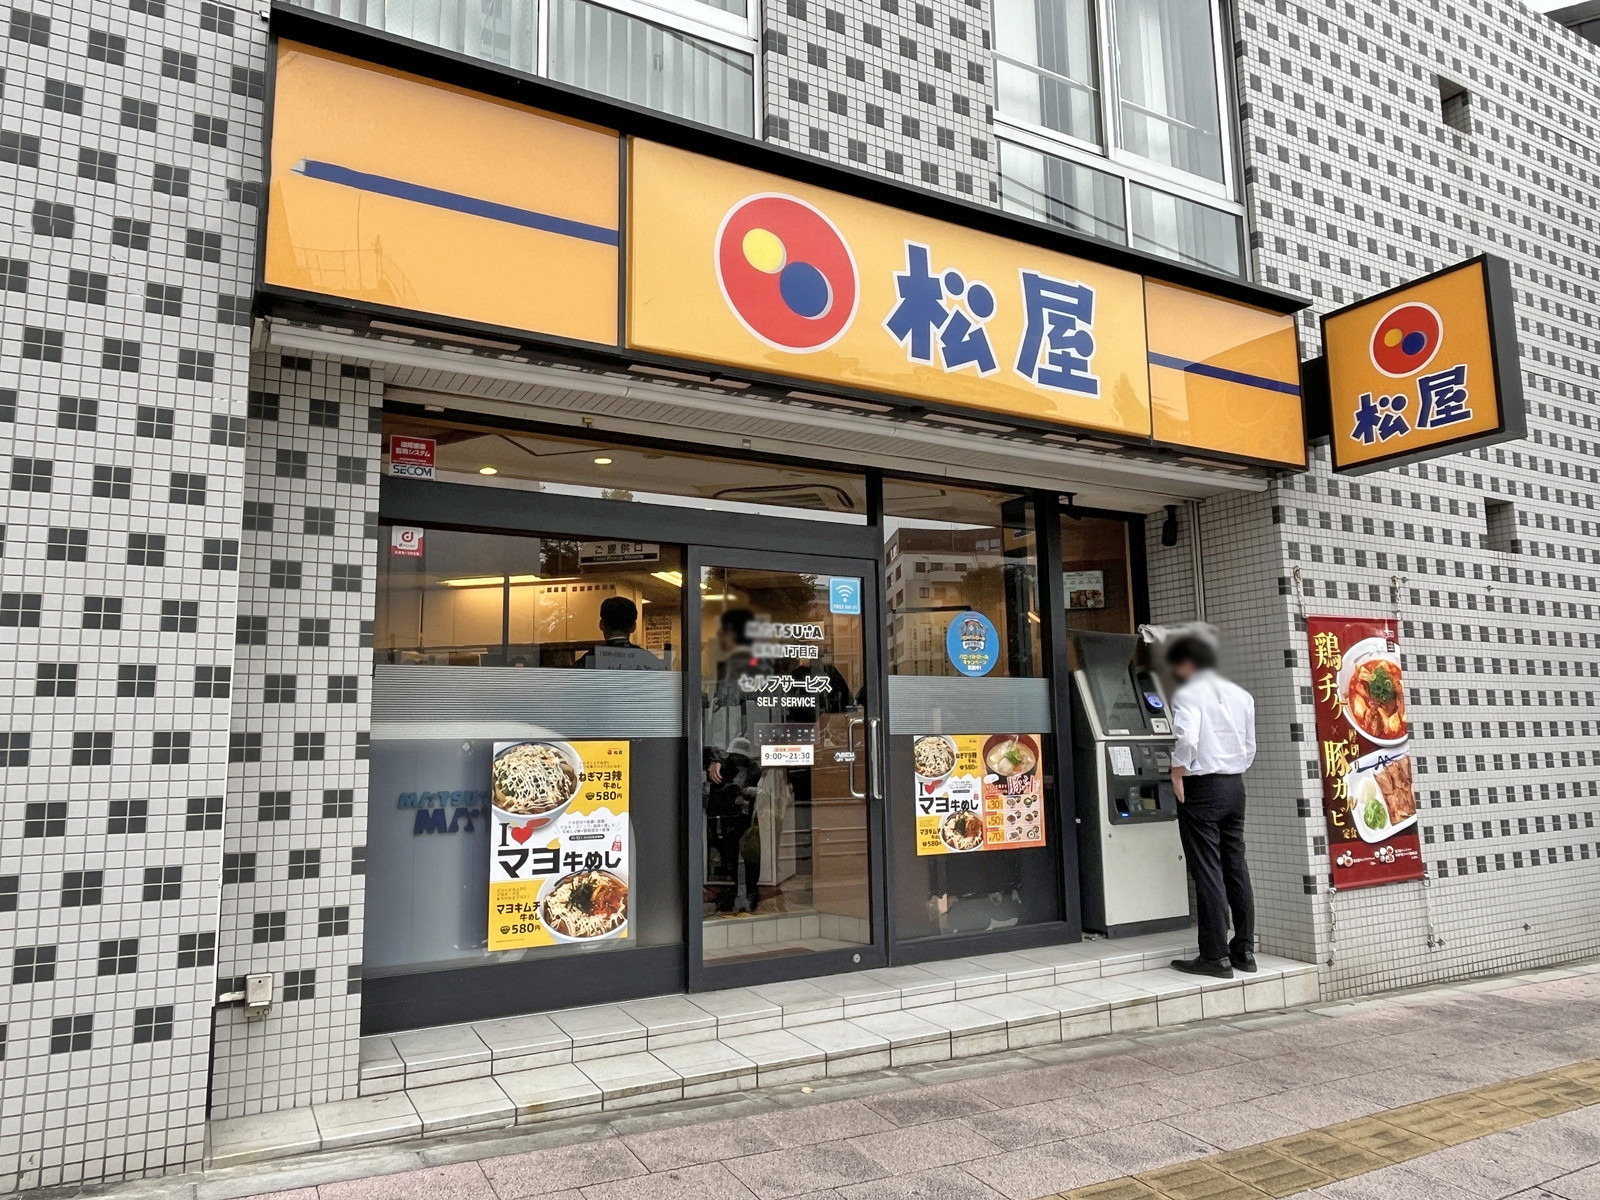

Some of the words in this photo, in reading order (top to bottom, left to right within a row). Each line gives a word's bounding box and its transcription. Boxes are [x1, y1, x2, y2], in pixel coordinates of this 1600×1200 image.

[882, 239, 1100, 399] 松屋
[1350, 364, 1472, 446] 松屋
[393, 464, 432, 477] SECOM
[738, 674, 833, 693] セルフサービス
[757, 696, 778, 707] SELF
[781, 696, 816, 708] SERVICE
[603, 782, 622, 790] 牛めし
[595, 791, 623, 801] 580円
[496, 901, 541, 915] マヨキムチ
[519, 913, 541, 922] 牛めし
[511, 923, 541, 935] 580円
